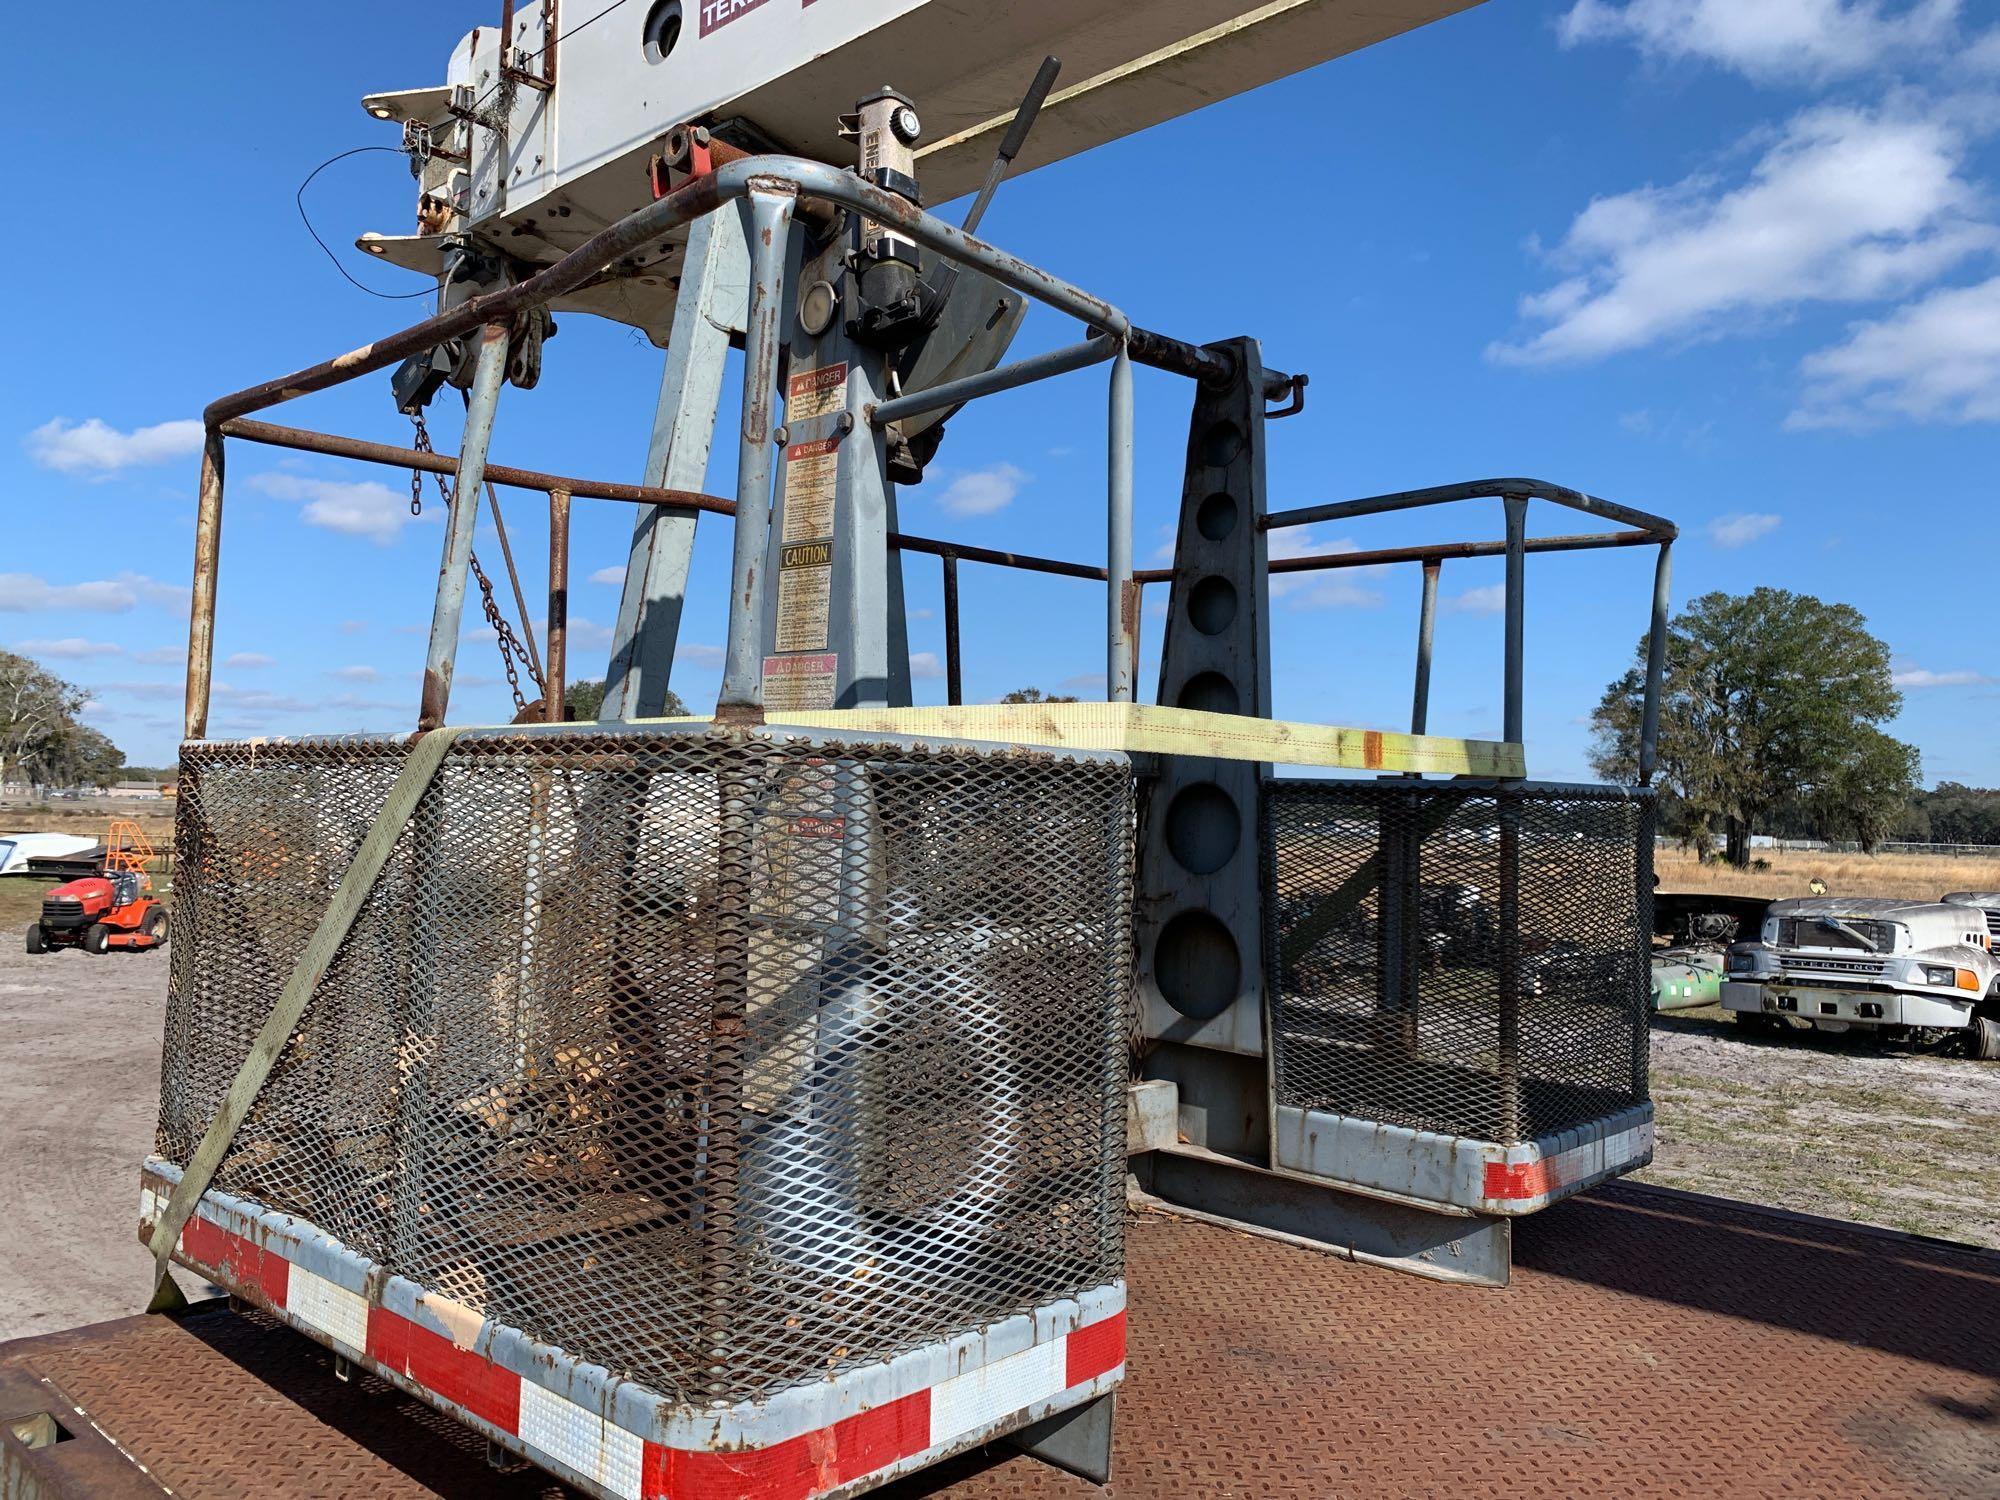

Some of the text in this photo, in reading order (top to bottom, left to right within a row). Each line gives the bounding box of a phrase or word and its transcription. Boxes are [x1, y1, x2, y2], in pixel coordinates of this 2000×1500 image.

[703, 0, 753, 27] TER
[805, 370, 841, 389] DANGER
[803, 441, 832, 454] DANGER
[785, 545, 828, 566] CAUTION
[785, 661, 824, 673] DANGER
[1787, 960, 1878, 972] STERLING
